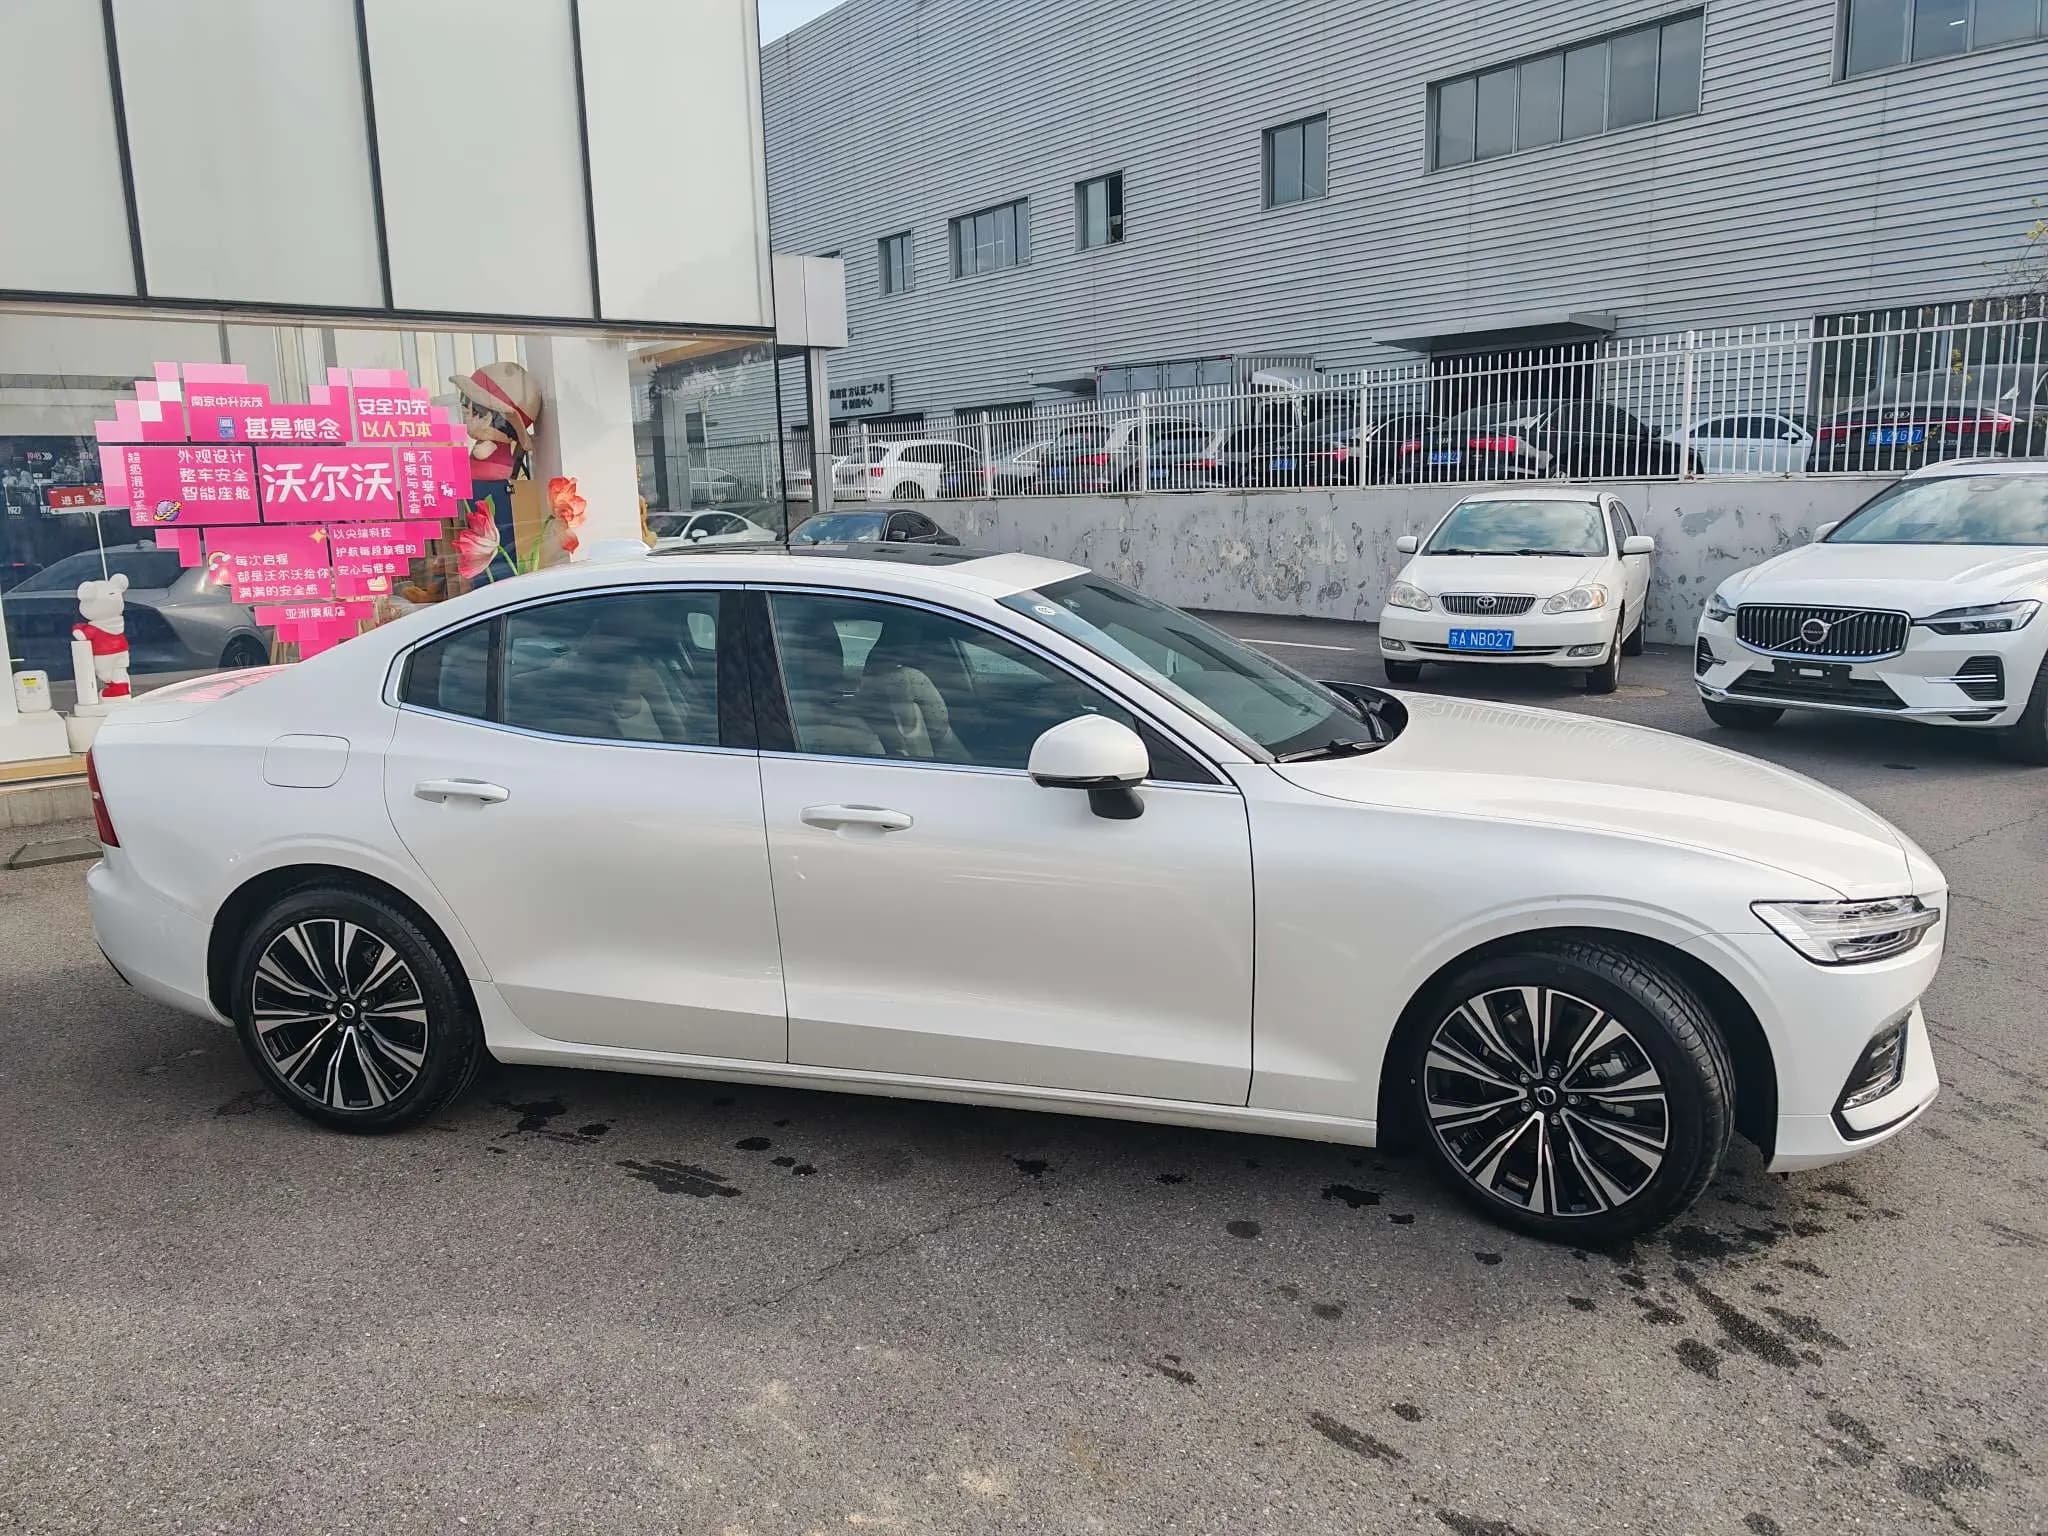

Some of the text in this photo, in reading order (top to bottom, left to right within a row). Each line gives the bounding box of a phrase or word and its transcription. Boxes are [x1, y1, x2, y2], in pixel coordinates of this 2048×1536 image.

[357, 398, 429, 416] 安全为先
[244, 416, 341, 439] 甚是想念
[362, 420, 432, 438] 以人为本
[178, 449, 246, 464] 外观设计
[180, 467, 249, 483] 整车安全
[261, 462, 395, 502] 沃尔沃
[418, 450, 438, 507] 不可辜负
[181, 486, 251, 501] 智能座舱
[235, 553, 289, 567] 每次启程
[236, 567, 329, 583] 都是沃尔沃给你
[239, 584, 319, 599] 满满的安全感
